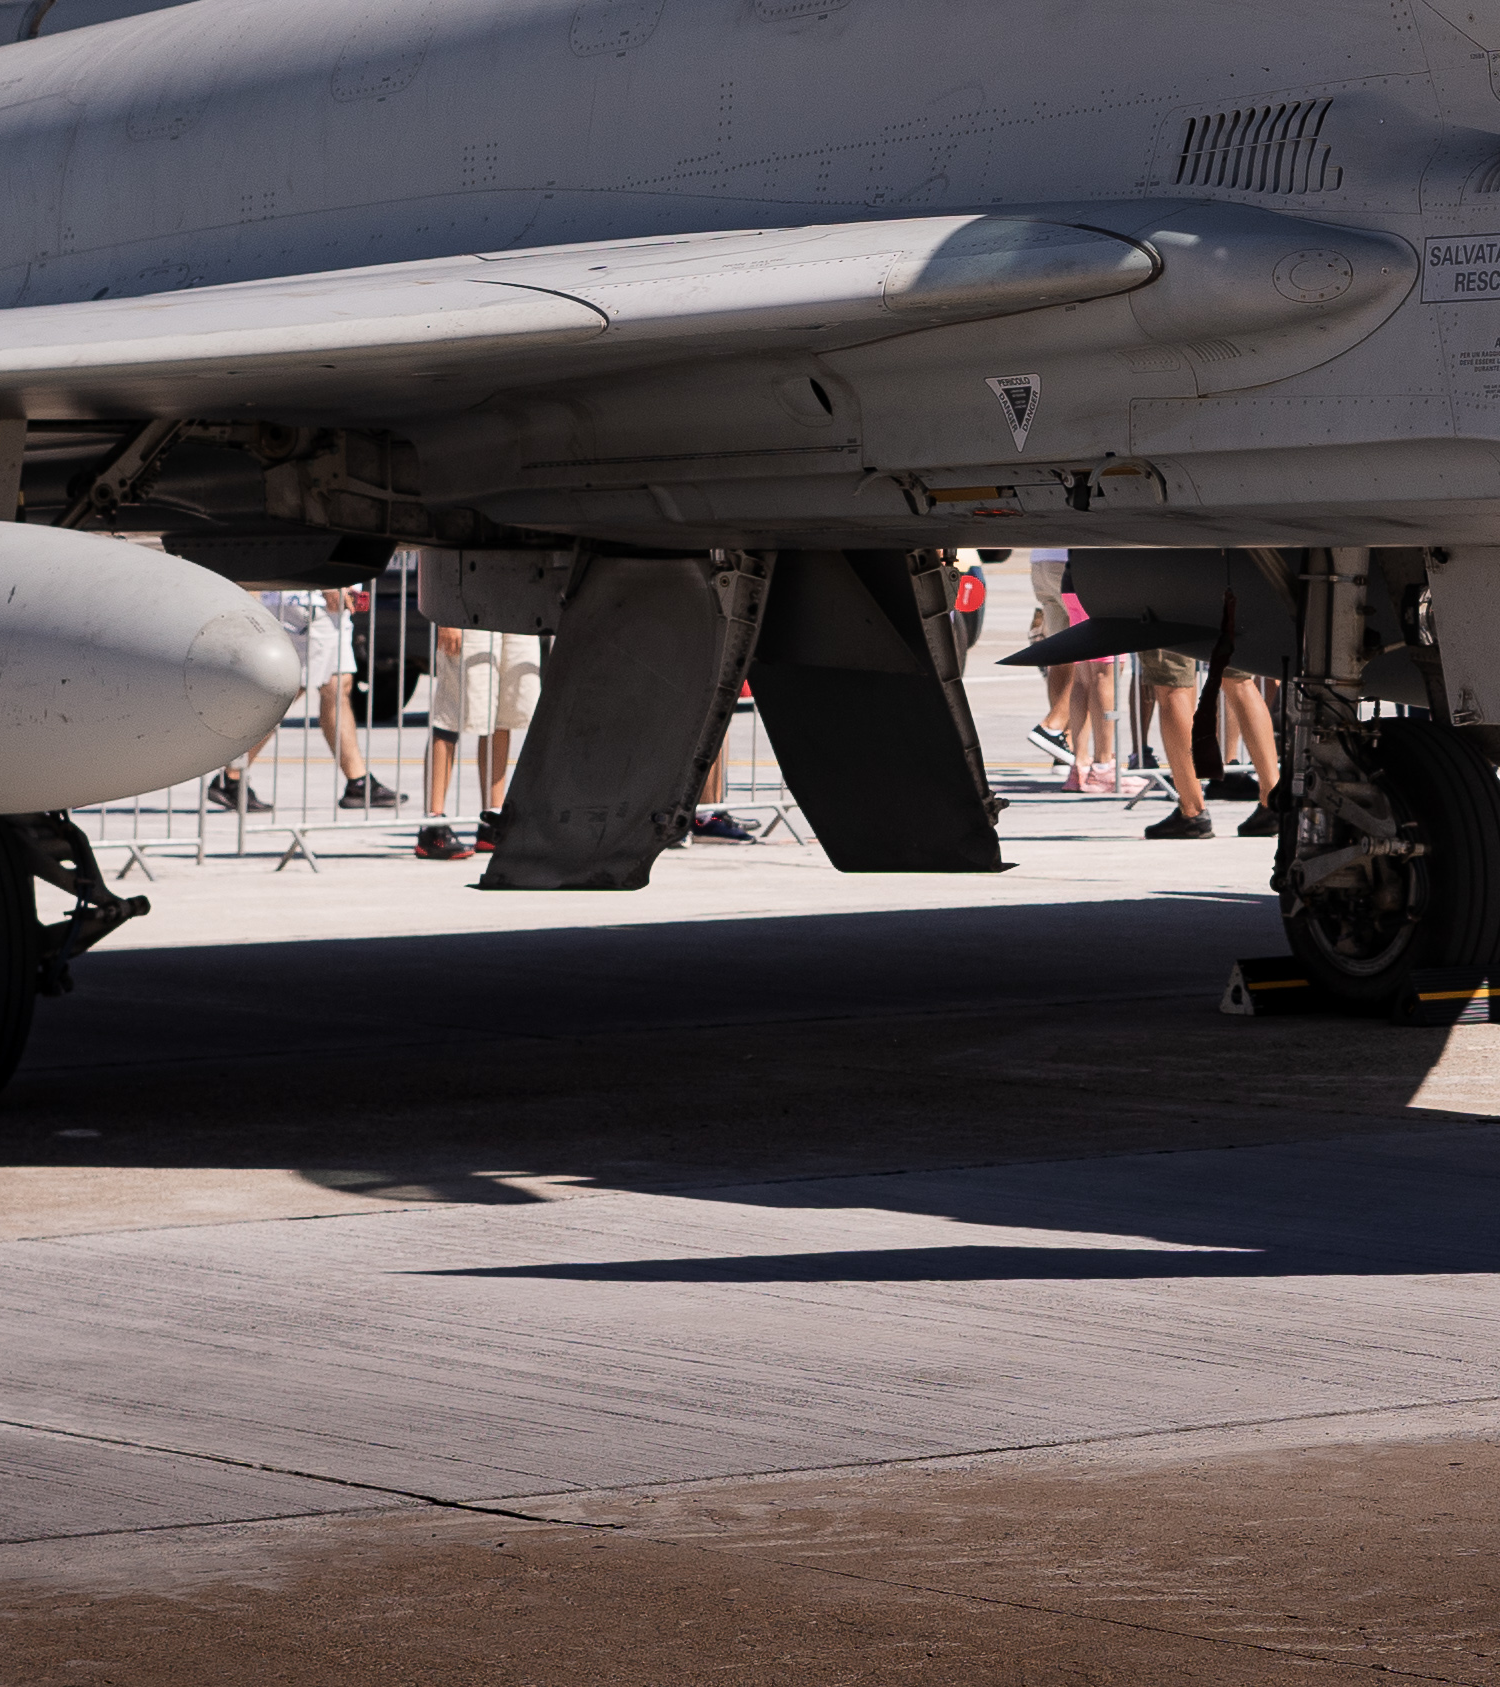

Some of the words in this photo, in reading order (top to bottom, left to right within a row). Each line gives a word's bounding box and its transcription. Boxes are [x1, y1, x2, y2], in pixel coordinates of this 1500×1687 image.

[1460, 351, 1471, 359] PER
[996, 377, 1031, 387] PERICOLO
[998, 392, 1019, 433] DANGER
[1021, 390, 1039, 432] DANGER
